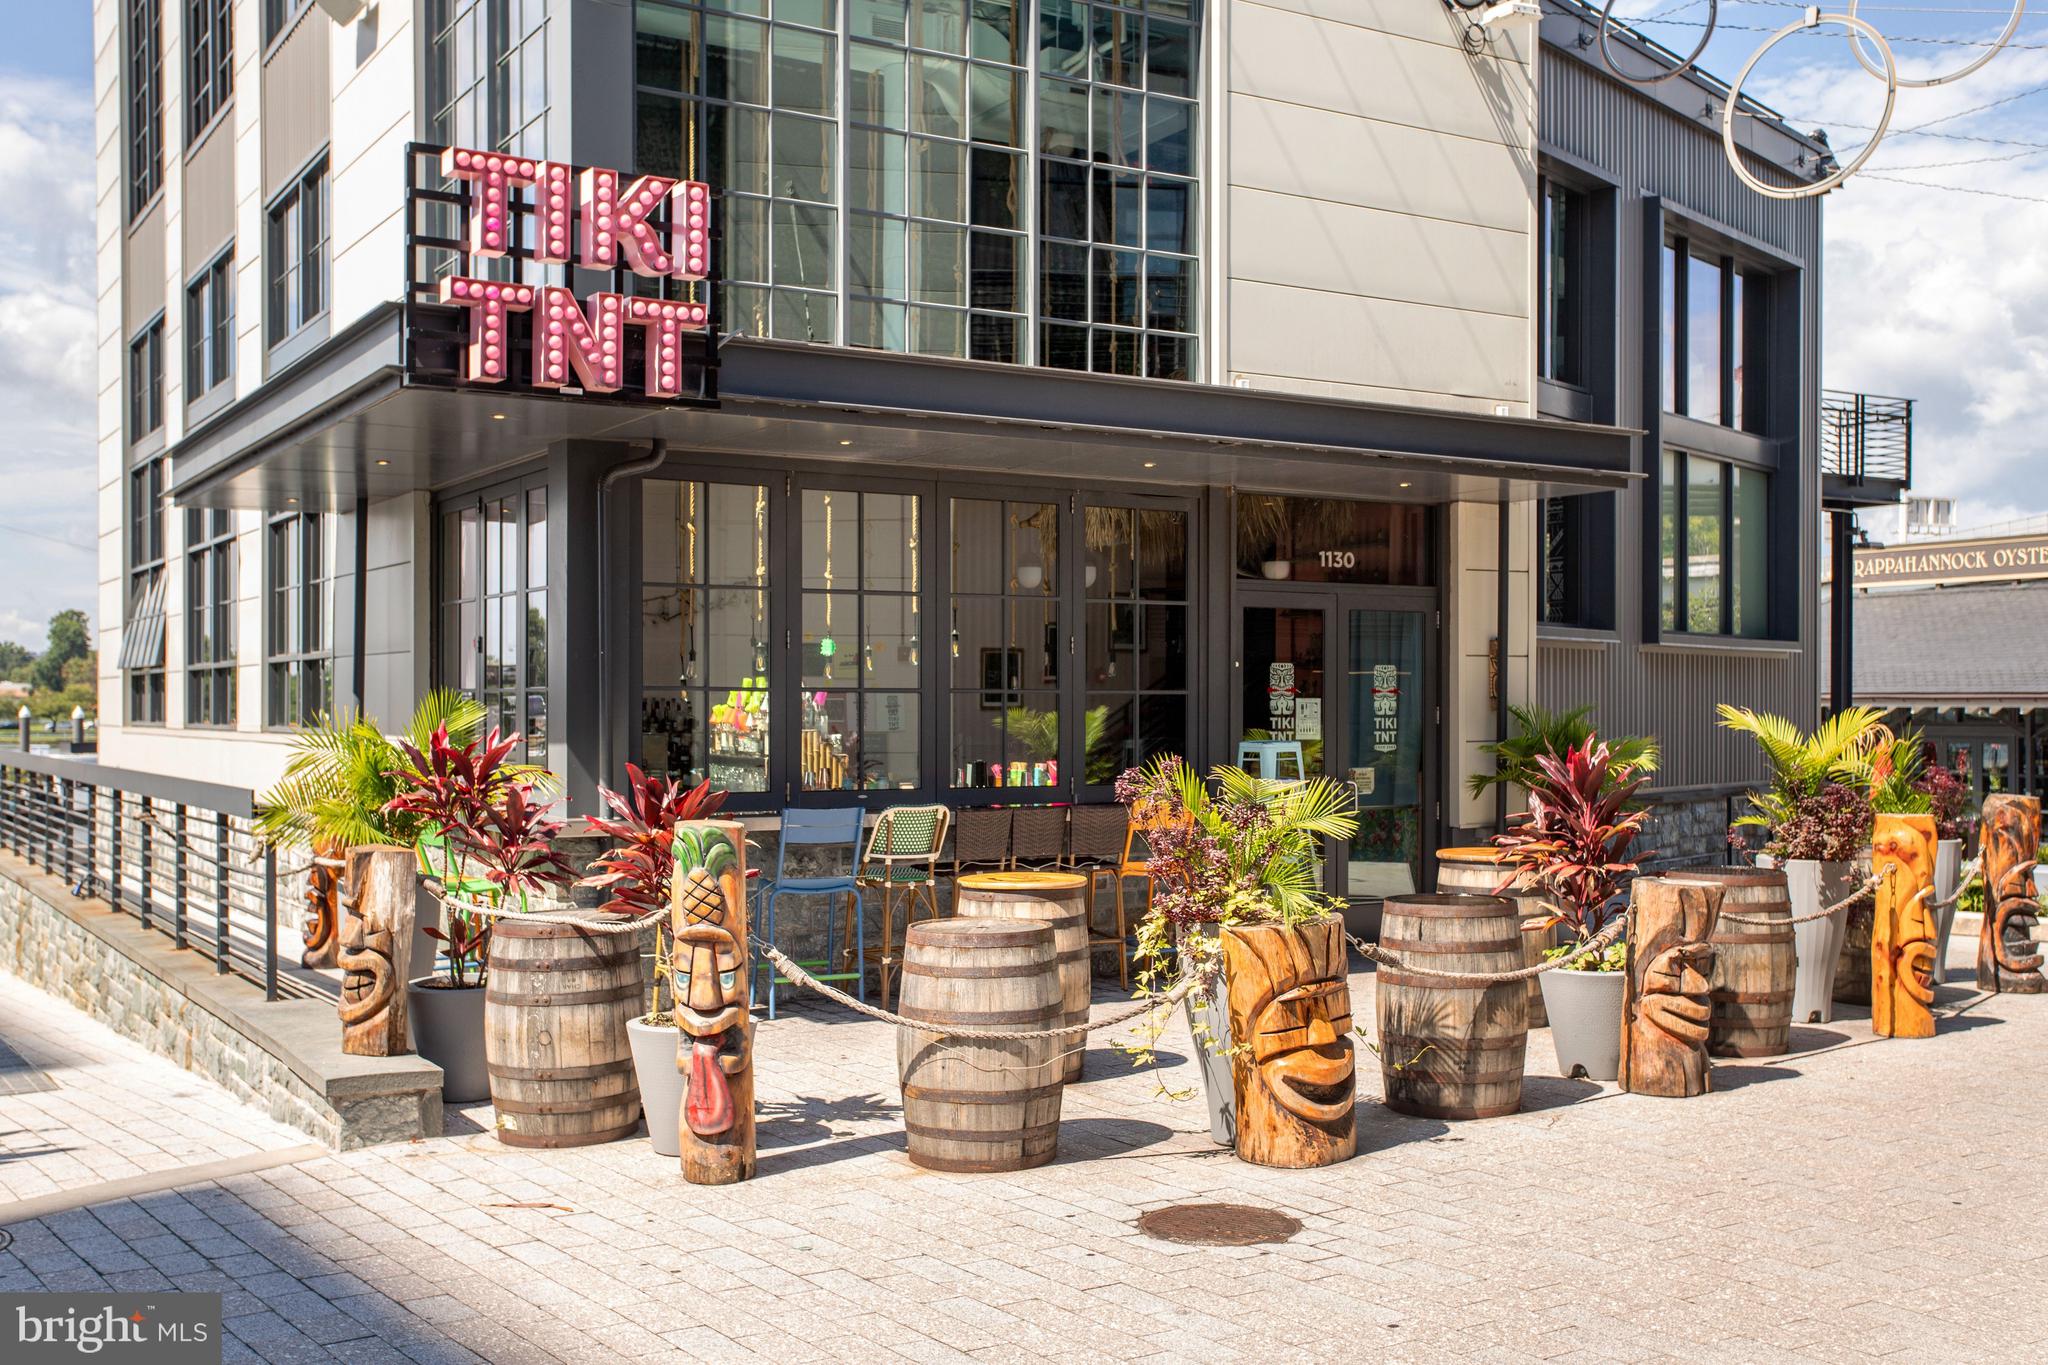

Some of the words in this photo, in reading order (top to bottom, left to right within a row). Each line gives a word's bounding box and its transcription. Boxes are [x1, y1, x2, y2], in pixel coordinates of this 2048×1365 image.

[441, 146, 709, 281] TIKI
[440, 275, 708, 398] TNT
[1319, 551, 1355, 568] 1130
[1855, 551, 1988, 577] RAPPAHANNOCK
[1270, 717, 1294, 729] TIKI
[1374, 717, 1397, 729] TIKI
[1270, 731, 1294, 741] TNT
[1374, 731, 1397, 743] TNT
